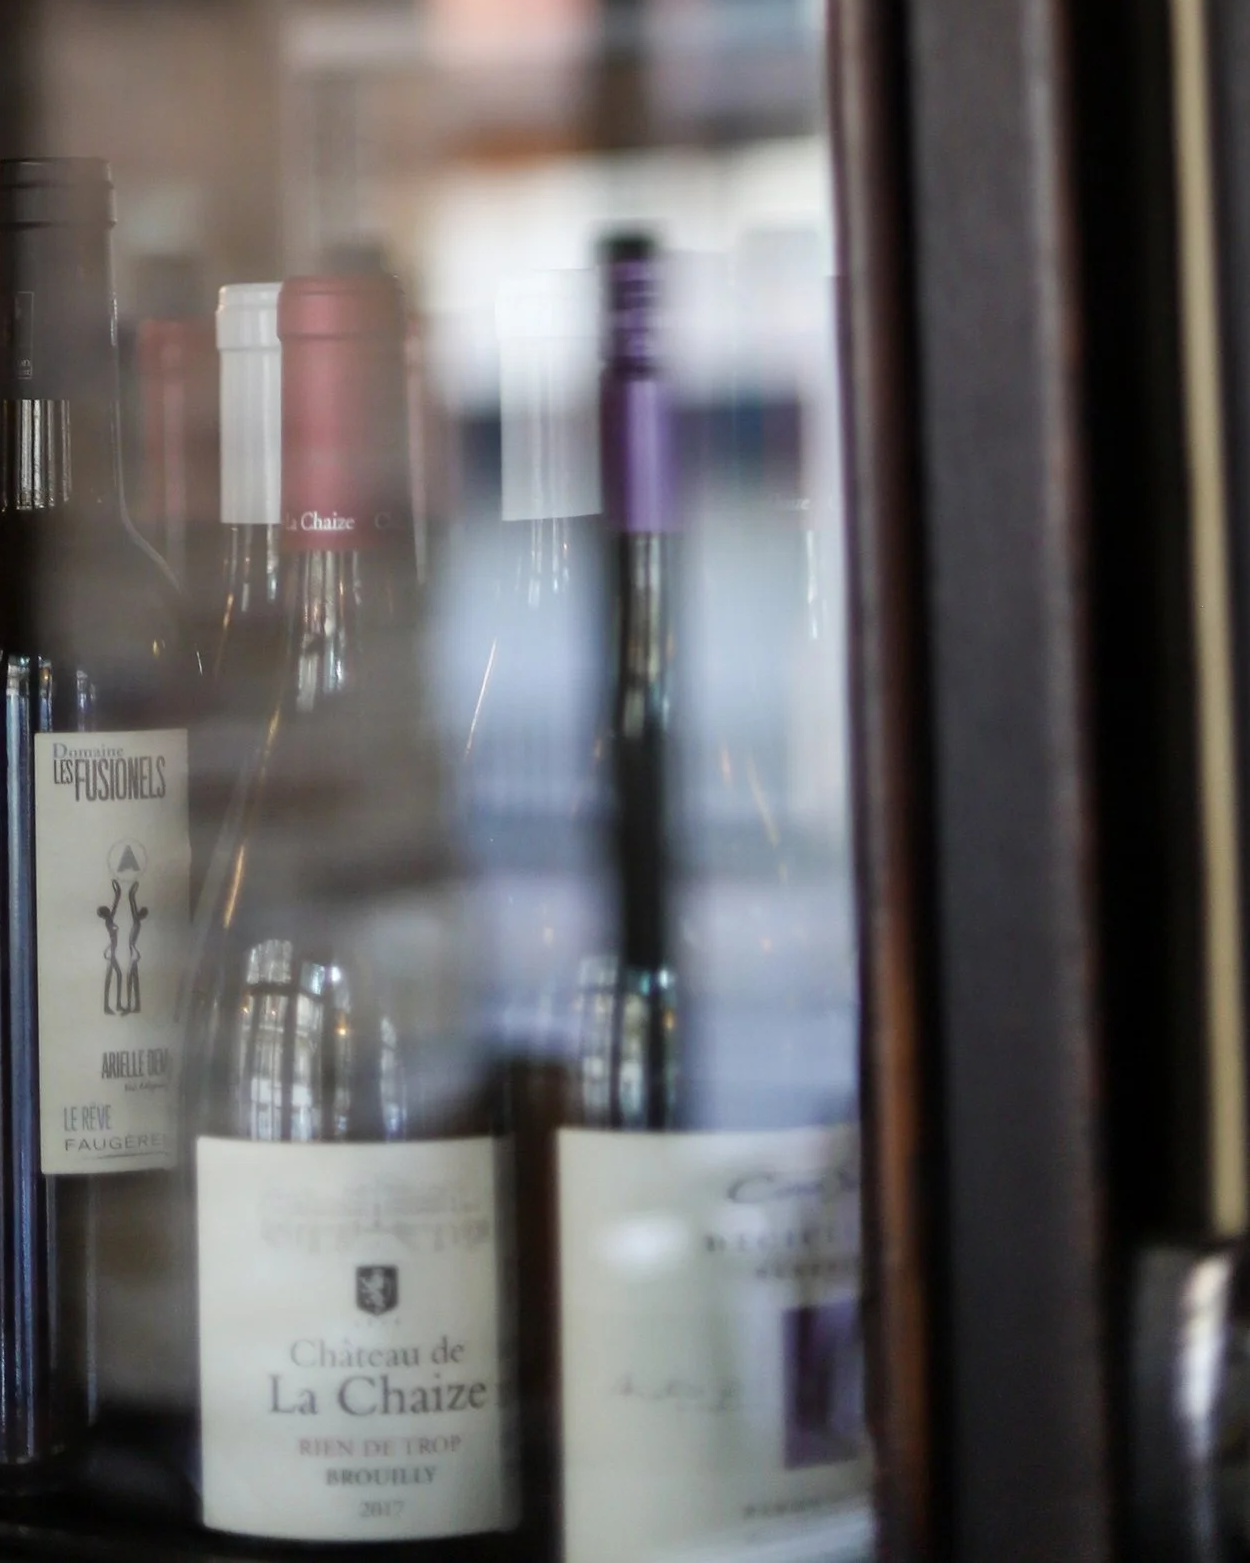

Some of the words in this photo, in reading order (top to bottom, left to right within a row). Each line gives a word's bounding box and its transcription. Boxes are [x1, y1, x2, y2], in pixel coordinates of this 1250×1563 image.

[300, 510, 356, 532] Chaize
[52, 741, 124, 759] Domaine
[53, 759, 73, 785] LES
[75, 755, 167, 802] FUSIONELS
[101, 1049, 145, 1080] ARIELLE
[63, 1105, 78, 1133] LE
[289, 1334, 421, 1369] Château
[430, 1334, 466, 1366] de
[268, 1372, 320, 1416] La
[336, 1372, 489, 1417] Chaize
[297, 1437, 354, 1457] RIEN
[362, 1437, 394, 1457] DE
[403, 1434, 463, 1456] TROP
[324, 1464, 438, 1487] BROUILLY
